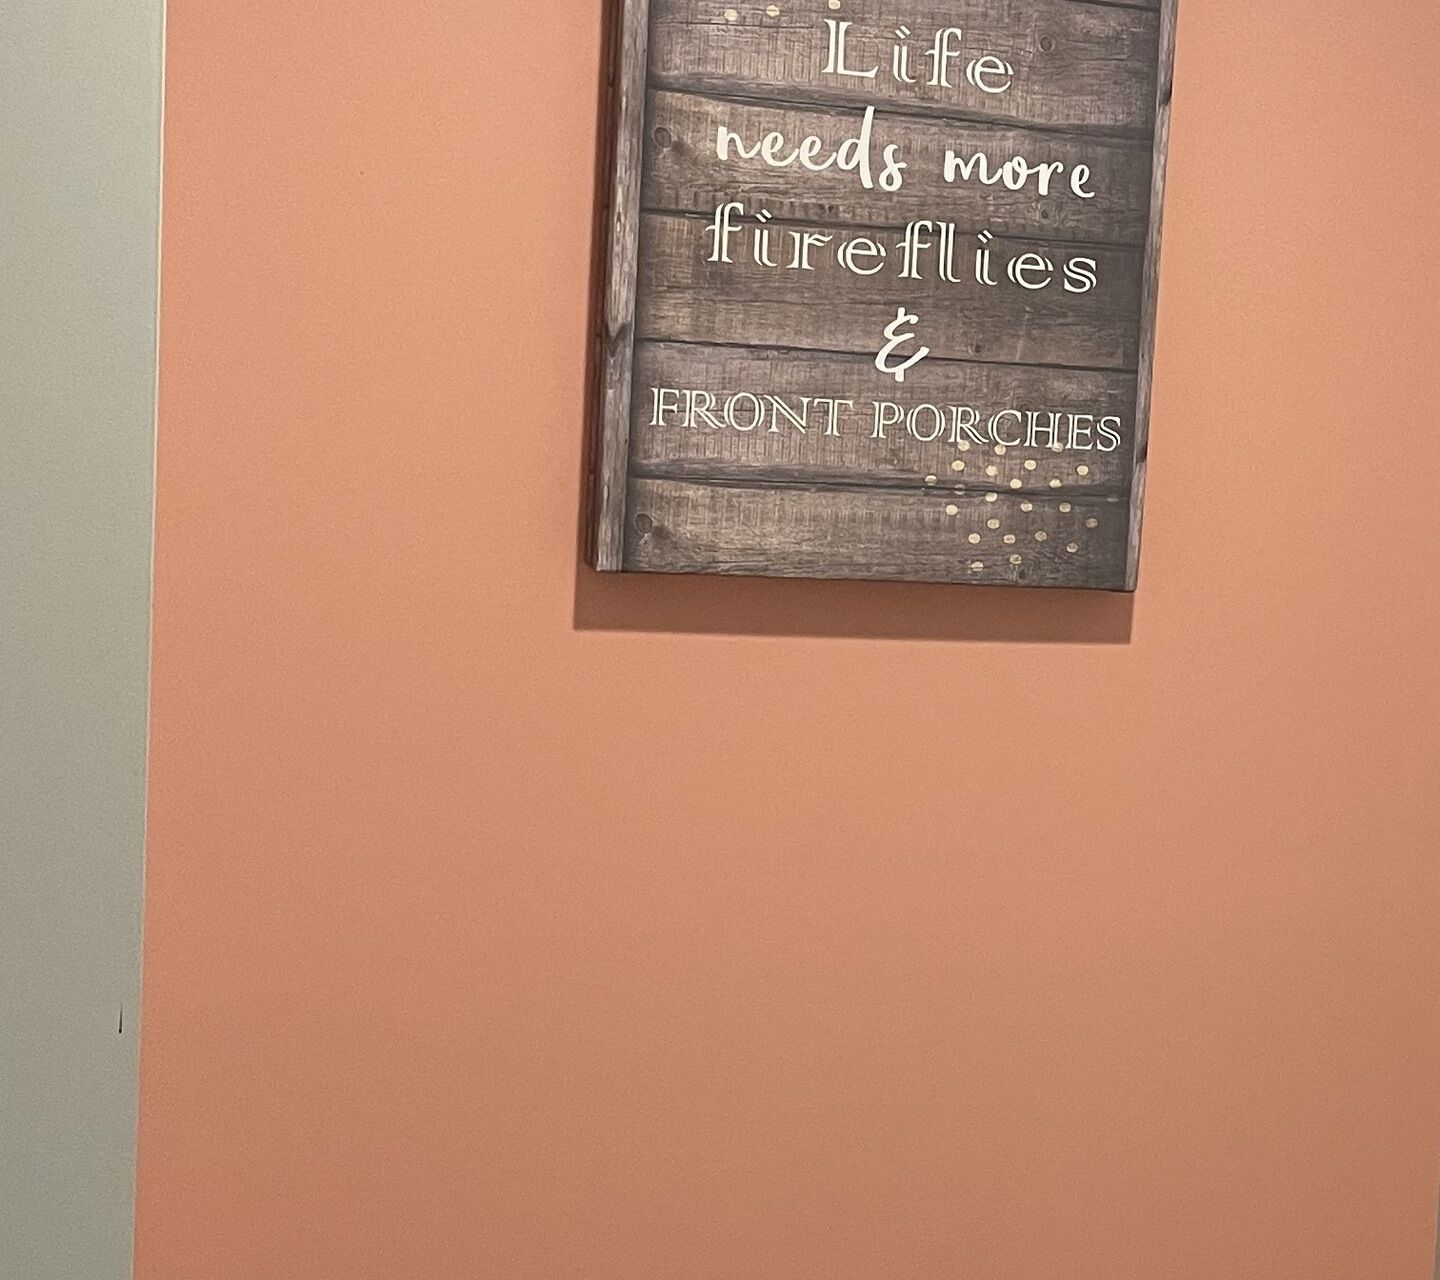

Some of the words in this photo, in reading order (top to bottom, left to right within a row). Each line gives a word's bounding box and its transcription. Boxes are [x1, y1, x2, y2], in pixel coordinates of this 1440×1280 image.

[821, 19, 1014, 94] Life
[716, 106, 906, 192] needs
[943, 151, 1096, 199] more
[706, 202, 1098, 293] fireflies
[874, 307, 929, 383] &
[649, 387, 853, 438] FRONT
[870, 400, 1122, 452] PORCHES
